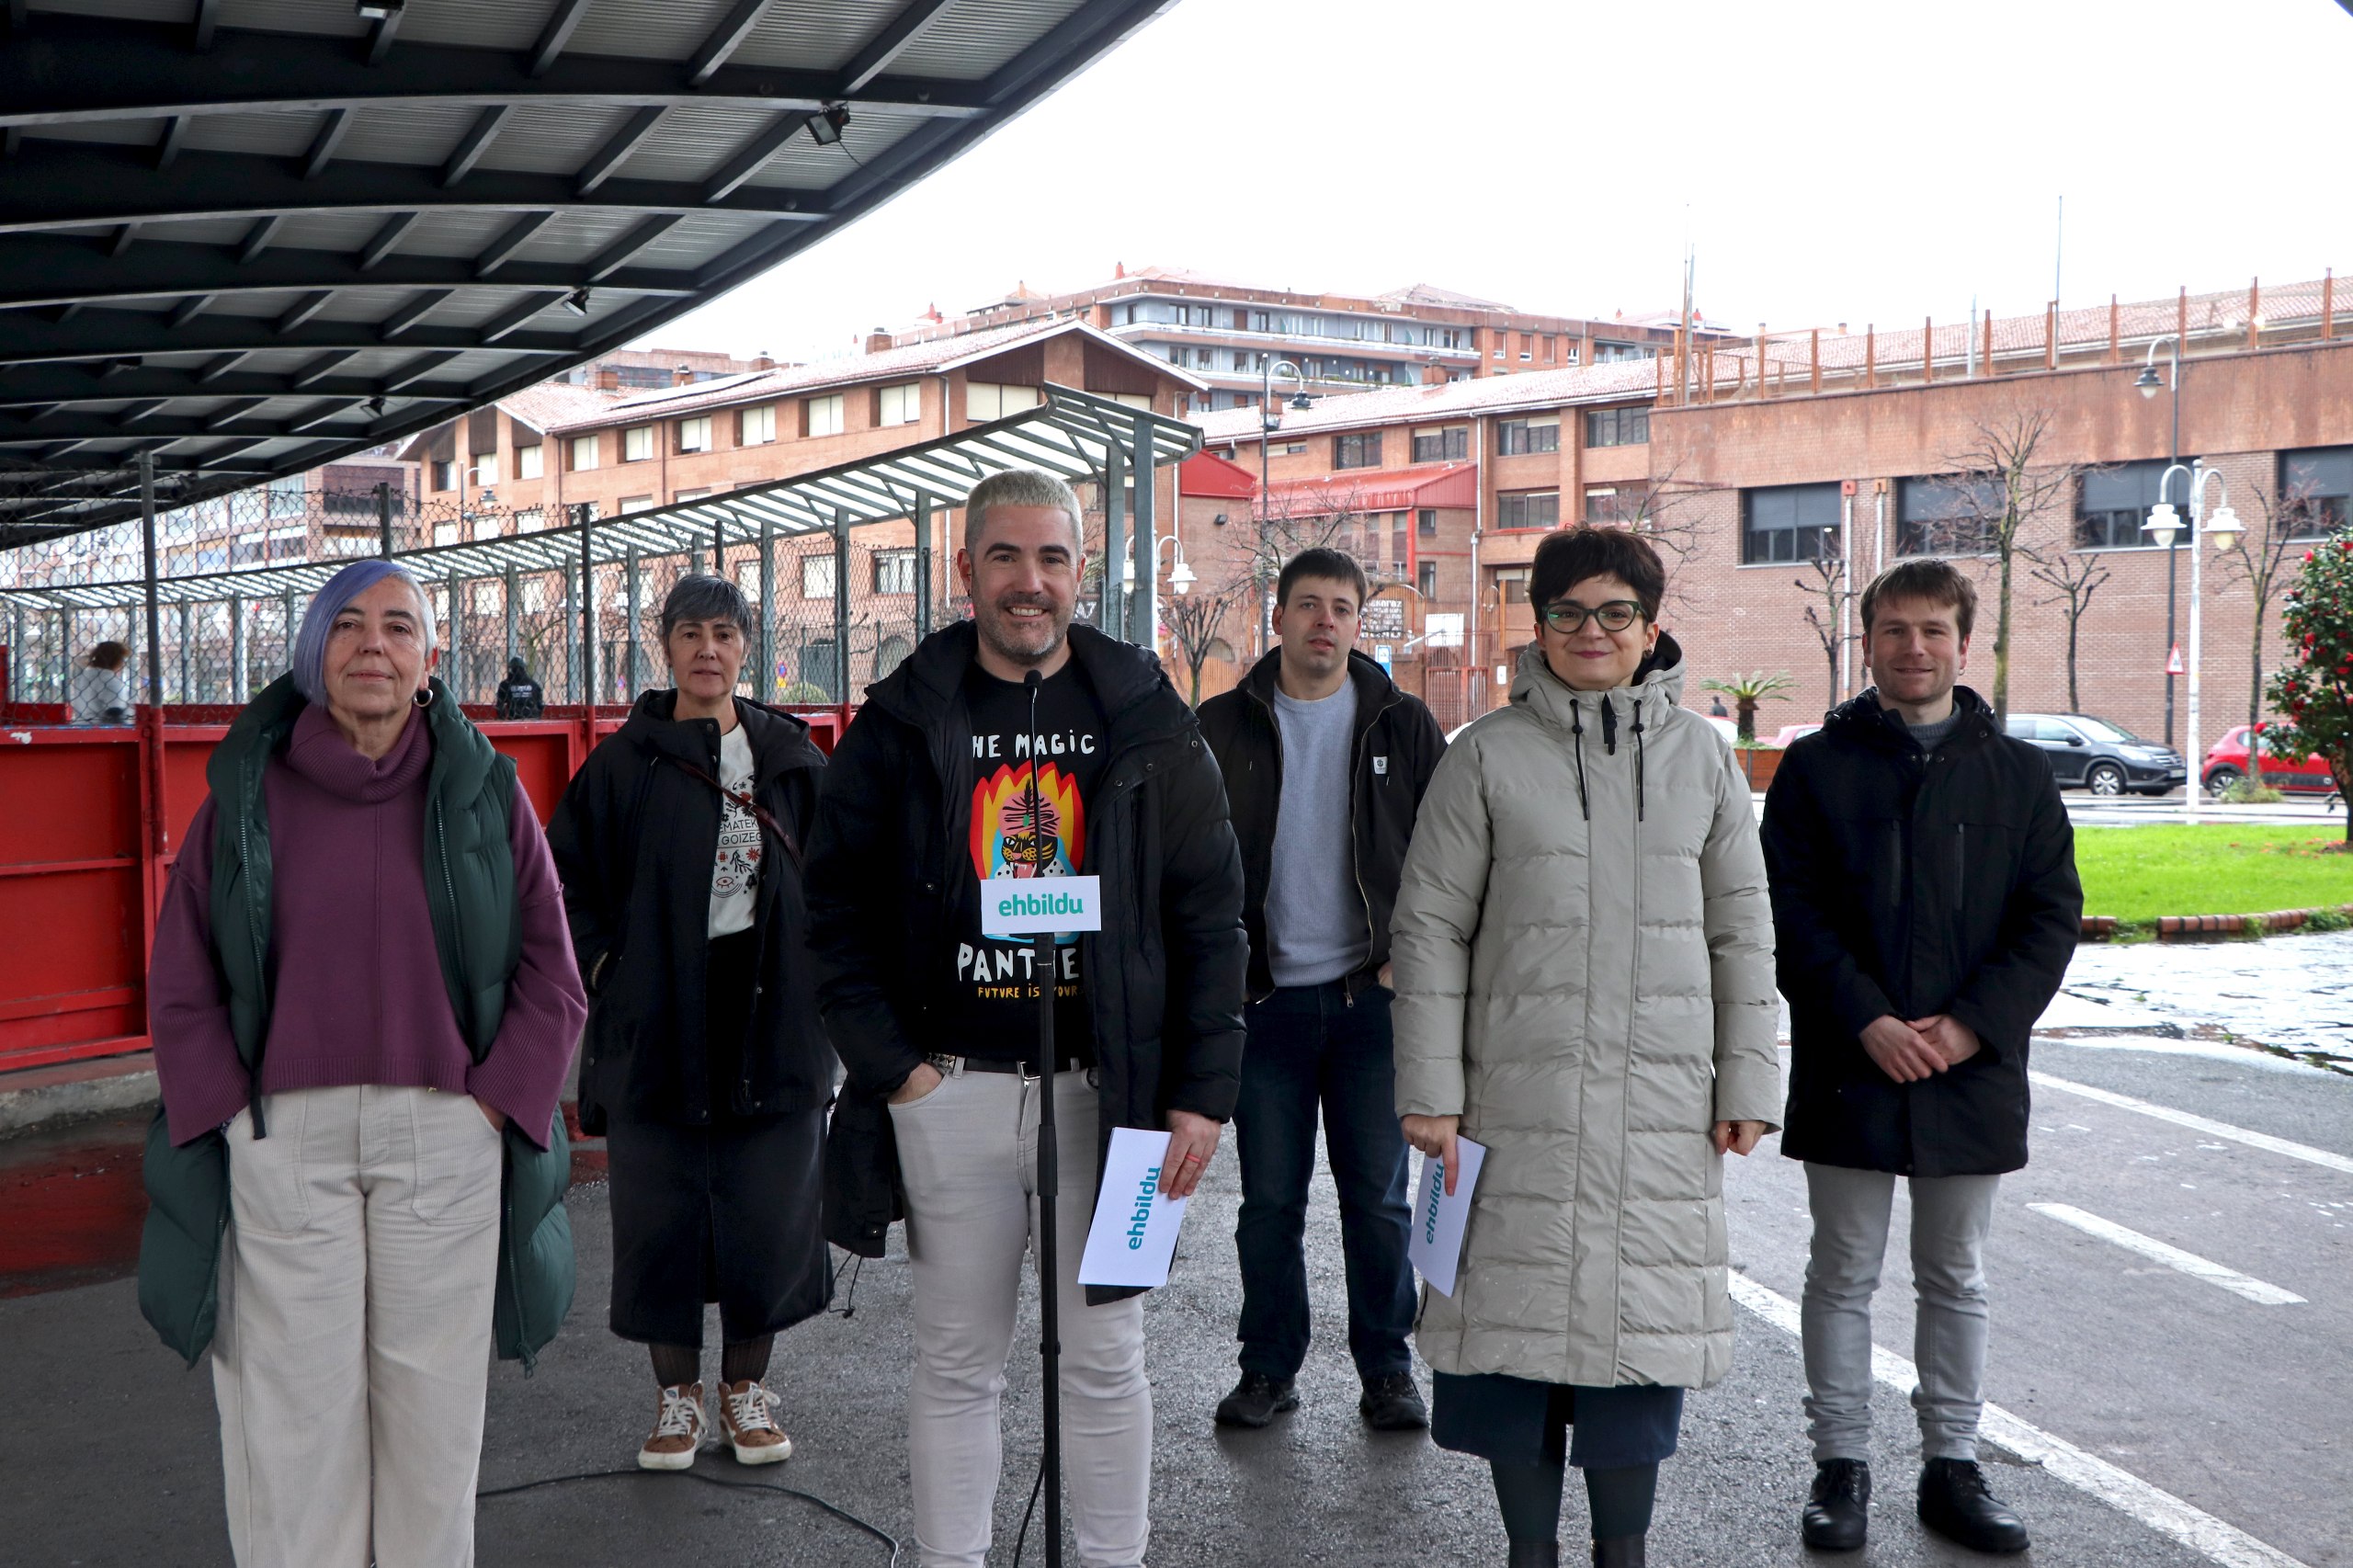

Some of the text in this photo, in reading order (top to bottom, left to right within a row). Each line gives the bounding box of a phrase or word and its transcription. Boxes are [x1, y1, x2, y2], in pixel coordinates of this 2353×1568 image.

[972, 733, 1002, 758] HE
[719, 818, 758, 834] EMATEK
[722, 833, 762, 846] GOIZEG
[998, 892, 1084, 916] ehbildu
[957, 942, 1080, 983] PANTE
[977, 986, 1019, 999] FUTURE
[1053, 984, 1082, 998] OUR
[1127, 1166, 1162, 1250] ehbildu
[1426, 1163, 1445, 1244] ehbildu
